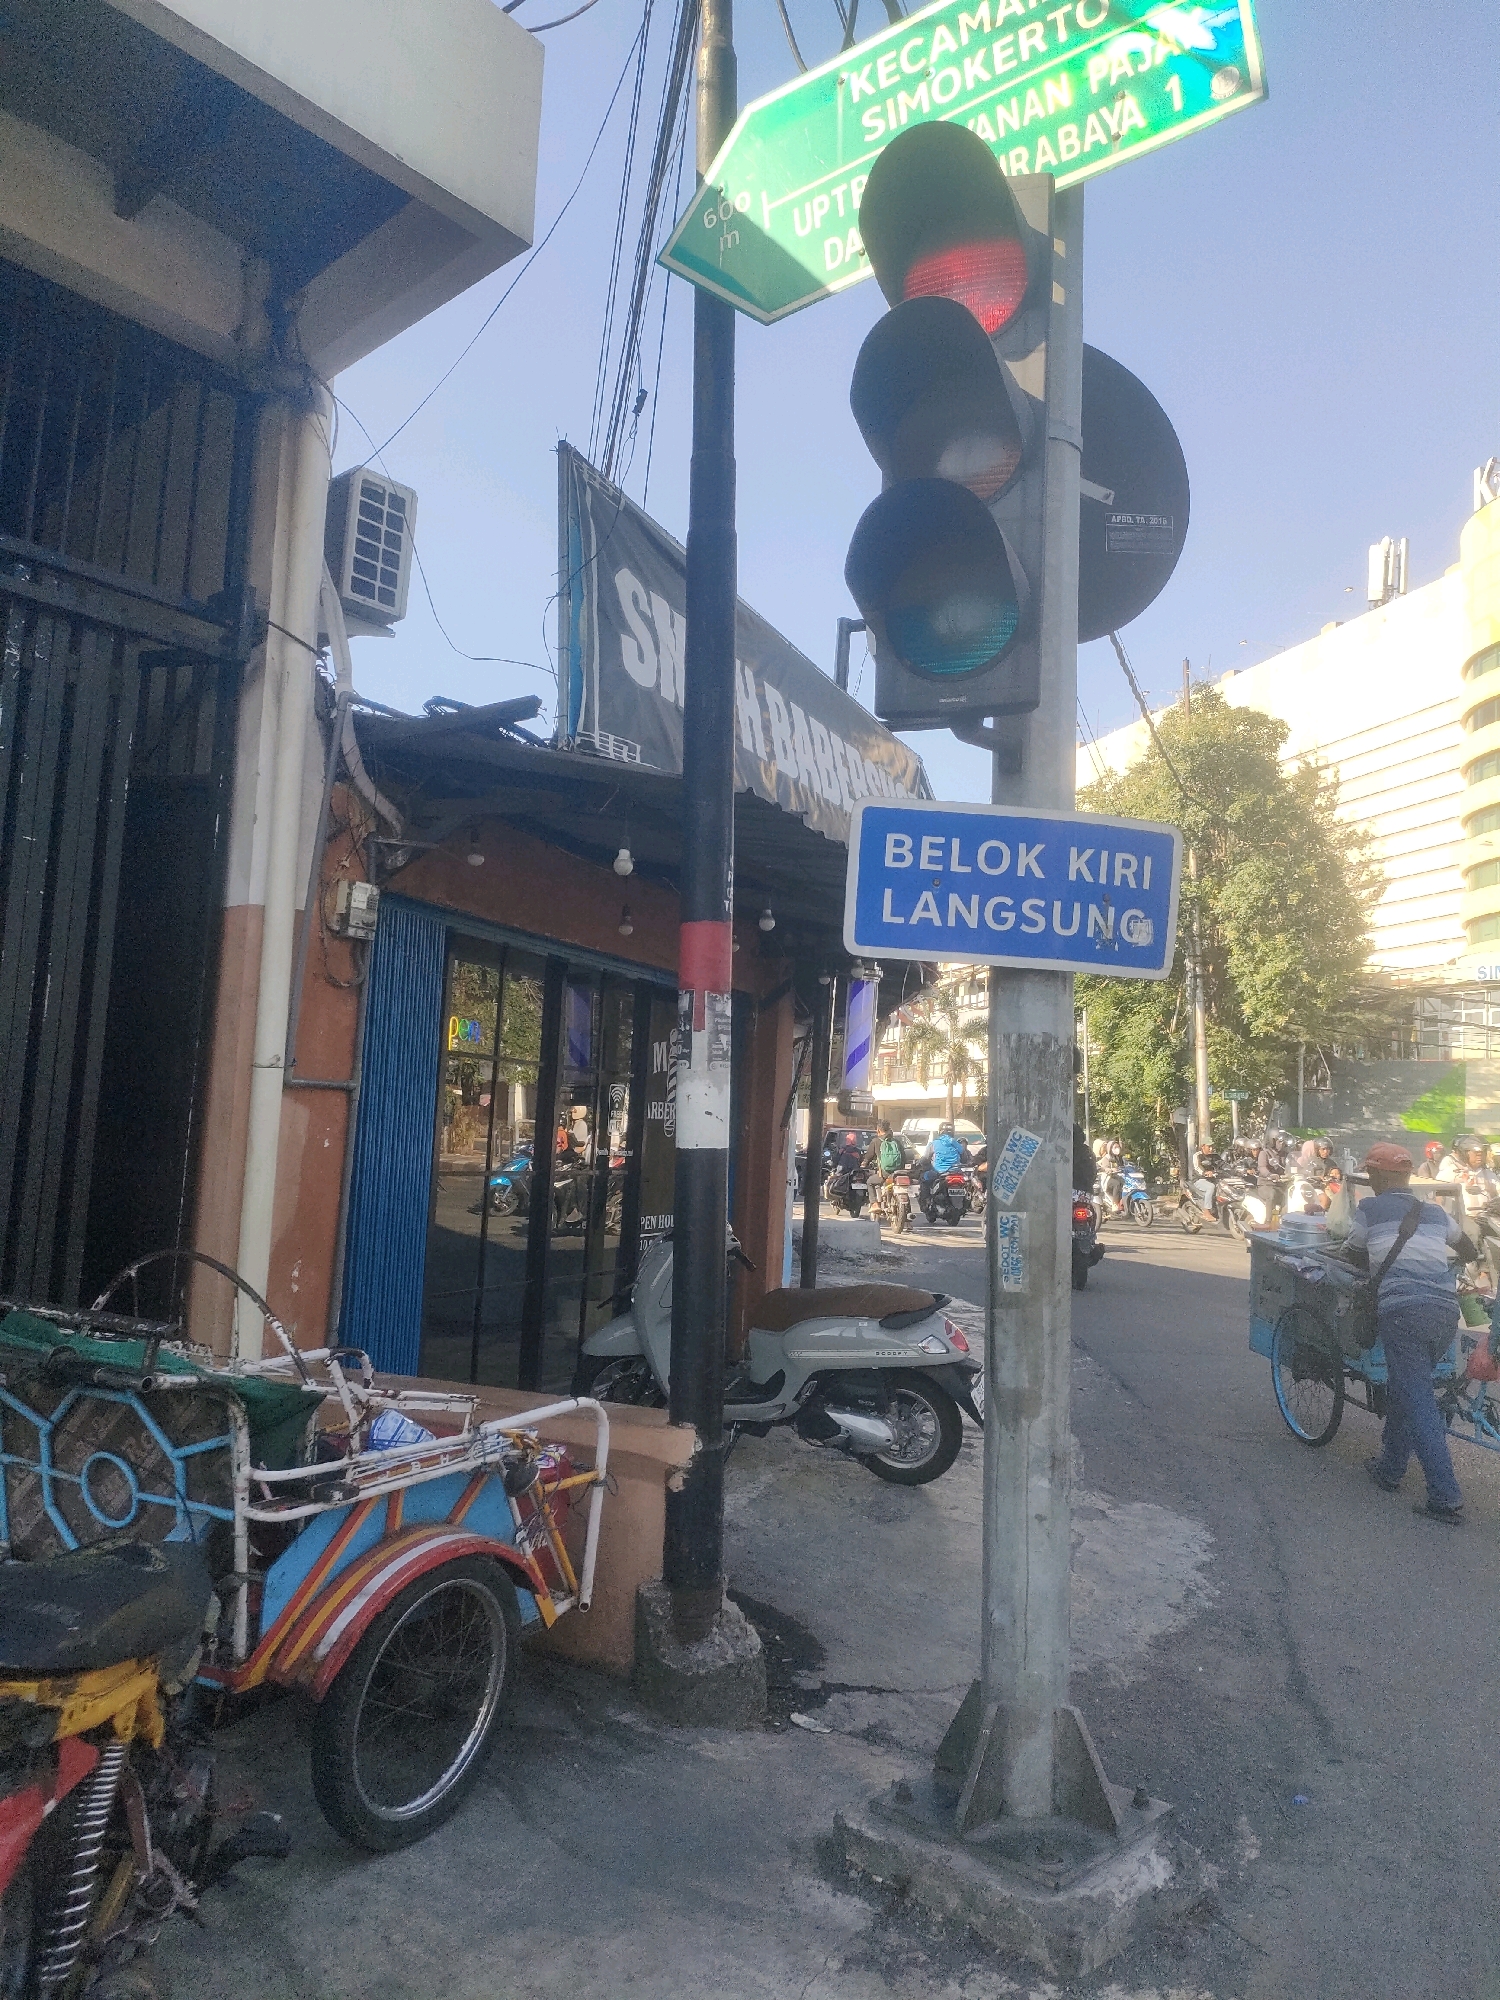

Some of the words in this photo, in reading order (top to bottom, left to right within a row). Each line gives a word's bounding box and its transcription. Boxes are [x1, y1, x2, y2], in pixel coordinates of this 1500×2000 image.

[861, 0, 1109, 142] SIMOKERTO
[1165, 74, 1183, 112] 1
[703, 191, 751, 229] 600
[884, 832, 1046, 879] BELOK
[1068, 846, 1152, 890] KIRI
[882, 888, 1154, 947] LANGSUNG
[1005, 1130, 1023, 1154] WC
[999, 1215, 1010, 1239] WC
[1001, 1244, 1010, 1283] SEDOT
